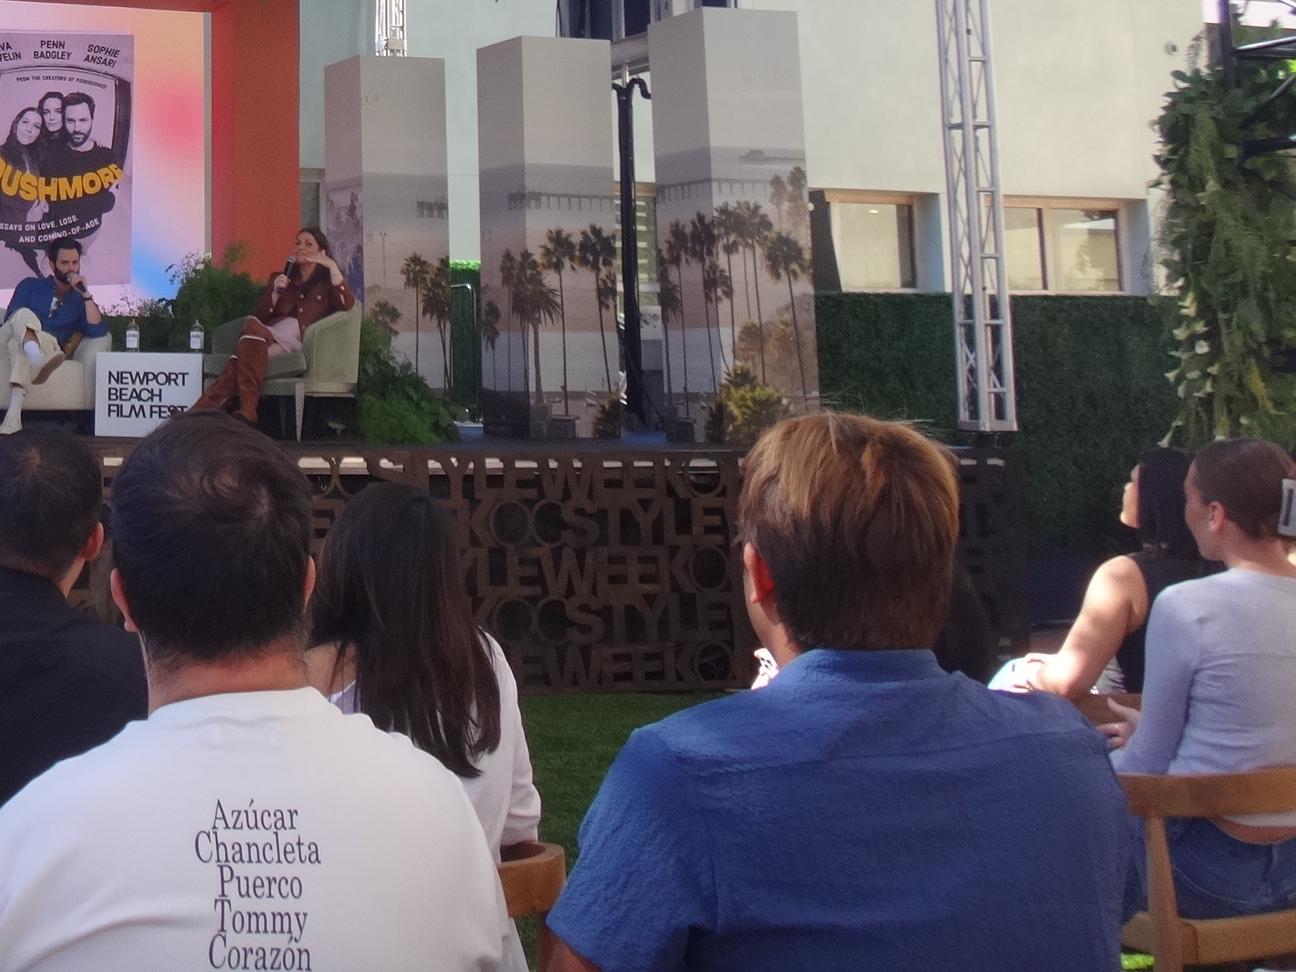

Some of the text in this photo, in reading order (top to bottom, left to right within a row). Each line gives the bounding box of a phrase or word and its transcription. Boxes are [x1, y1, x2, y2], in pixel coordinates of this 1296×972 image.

[40, 40, 65, 49] PENN
[87, 44, 121, 58] SOPHIE
[33, 51, 72, 60] BADGLEY
[84, 55, 117, 68] ANSARI
[25, 223, 36, 231] ON
[19, 235, 35, 243] AND
[108, 371, 189, 386] NEWPORT
[108, 387, 162, 402] BEACH
[108, 404, 146, 418] FILM
[211, 798, 299, 830] Azúcar
[194, 830, 322, 864] Chancleta
[217, 864, 303, 899] Puerco
[214, 898, 308, 943] Tommy
[208, 933, 312, 972] Corazón
